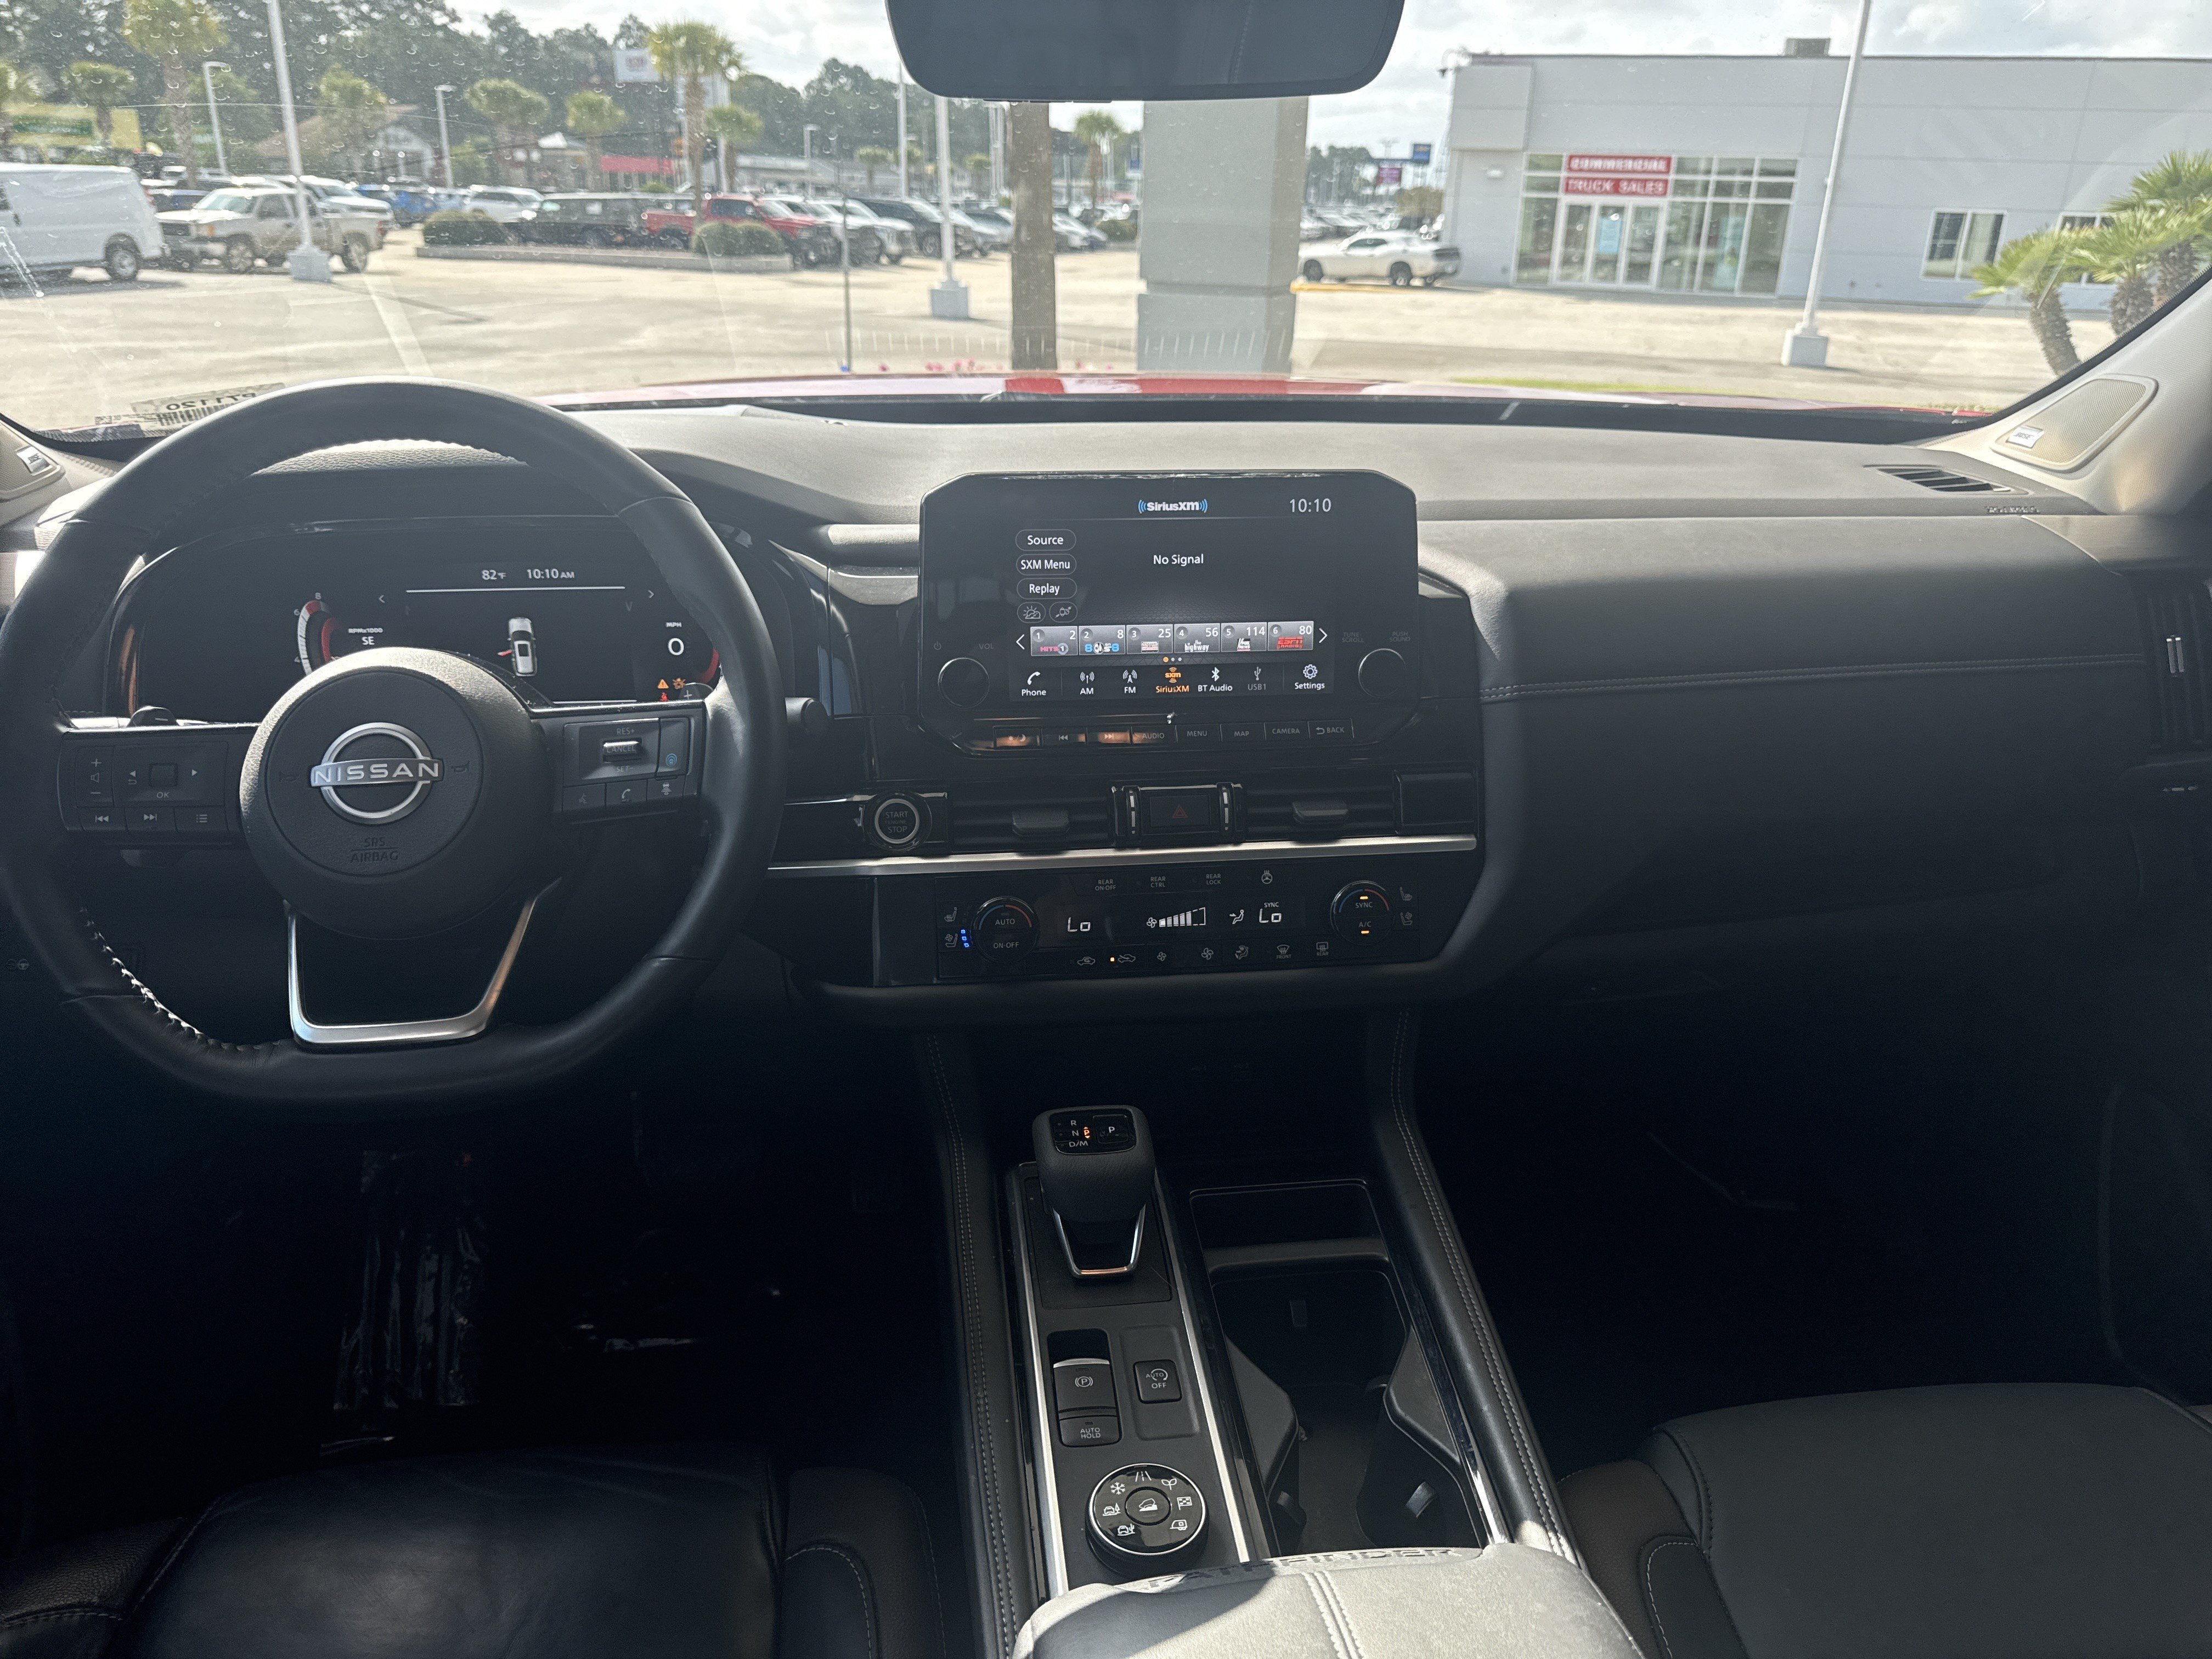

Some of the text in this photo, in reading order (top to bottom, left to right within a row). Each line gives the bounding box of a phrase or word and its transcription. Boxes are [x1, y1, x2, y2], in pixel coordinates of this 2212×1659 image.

[1569, 156, 1668, 172] COMMERCIAL
[1568, 179, 1666, 194] TRUCK SALES
[1289, 498, 1332, 513] 10:10
[1026, 535, 1064, 545] Source
[1020, 559, 1070, 569] SXM Menu
[1153, 554, 1204, 566] No Signal
[527, 568, 558, 579] 10:10
[1029, 583, 1060, 596] Replay
[1069, 630, 1076, 640] 2
[1117, 629, 1124, 639] 8
[1158, 628, 1171, 638] 25
[1205, 627, 1218, 637] 56
[1246, 627, 1265, 636] 114
[1299, 625, 1313, 635] 80
[362, 636, 375, 645] SE
[667, 637, 685, 656] 0
[1184, 642, 1209, 653] highway
[1155, 685, 1189, 693] SiriusXM
[1209, 684, 1233, 692] Audio
[1294, 682, 1325, 691] Settings
[314, 762, 439, 784] NISSAN
[364, 837, 385, 847] SRS
[350, 851, 399, 863] AIRBAG
[1259, 908, 1282, 923] Lo
[1067, 917, 1091, 932] Lo
